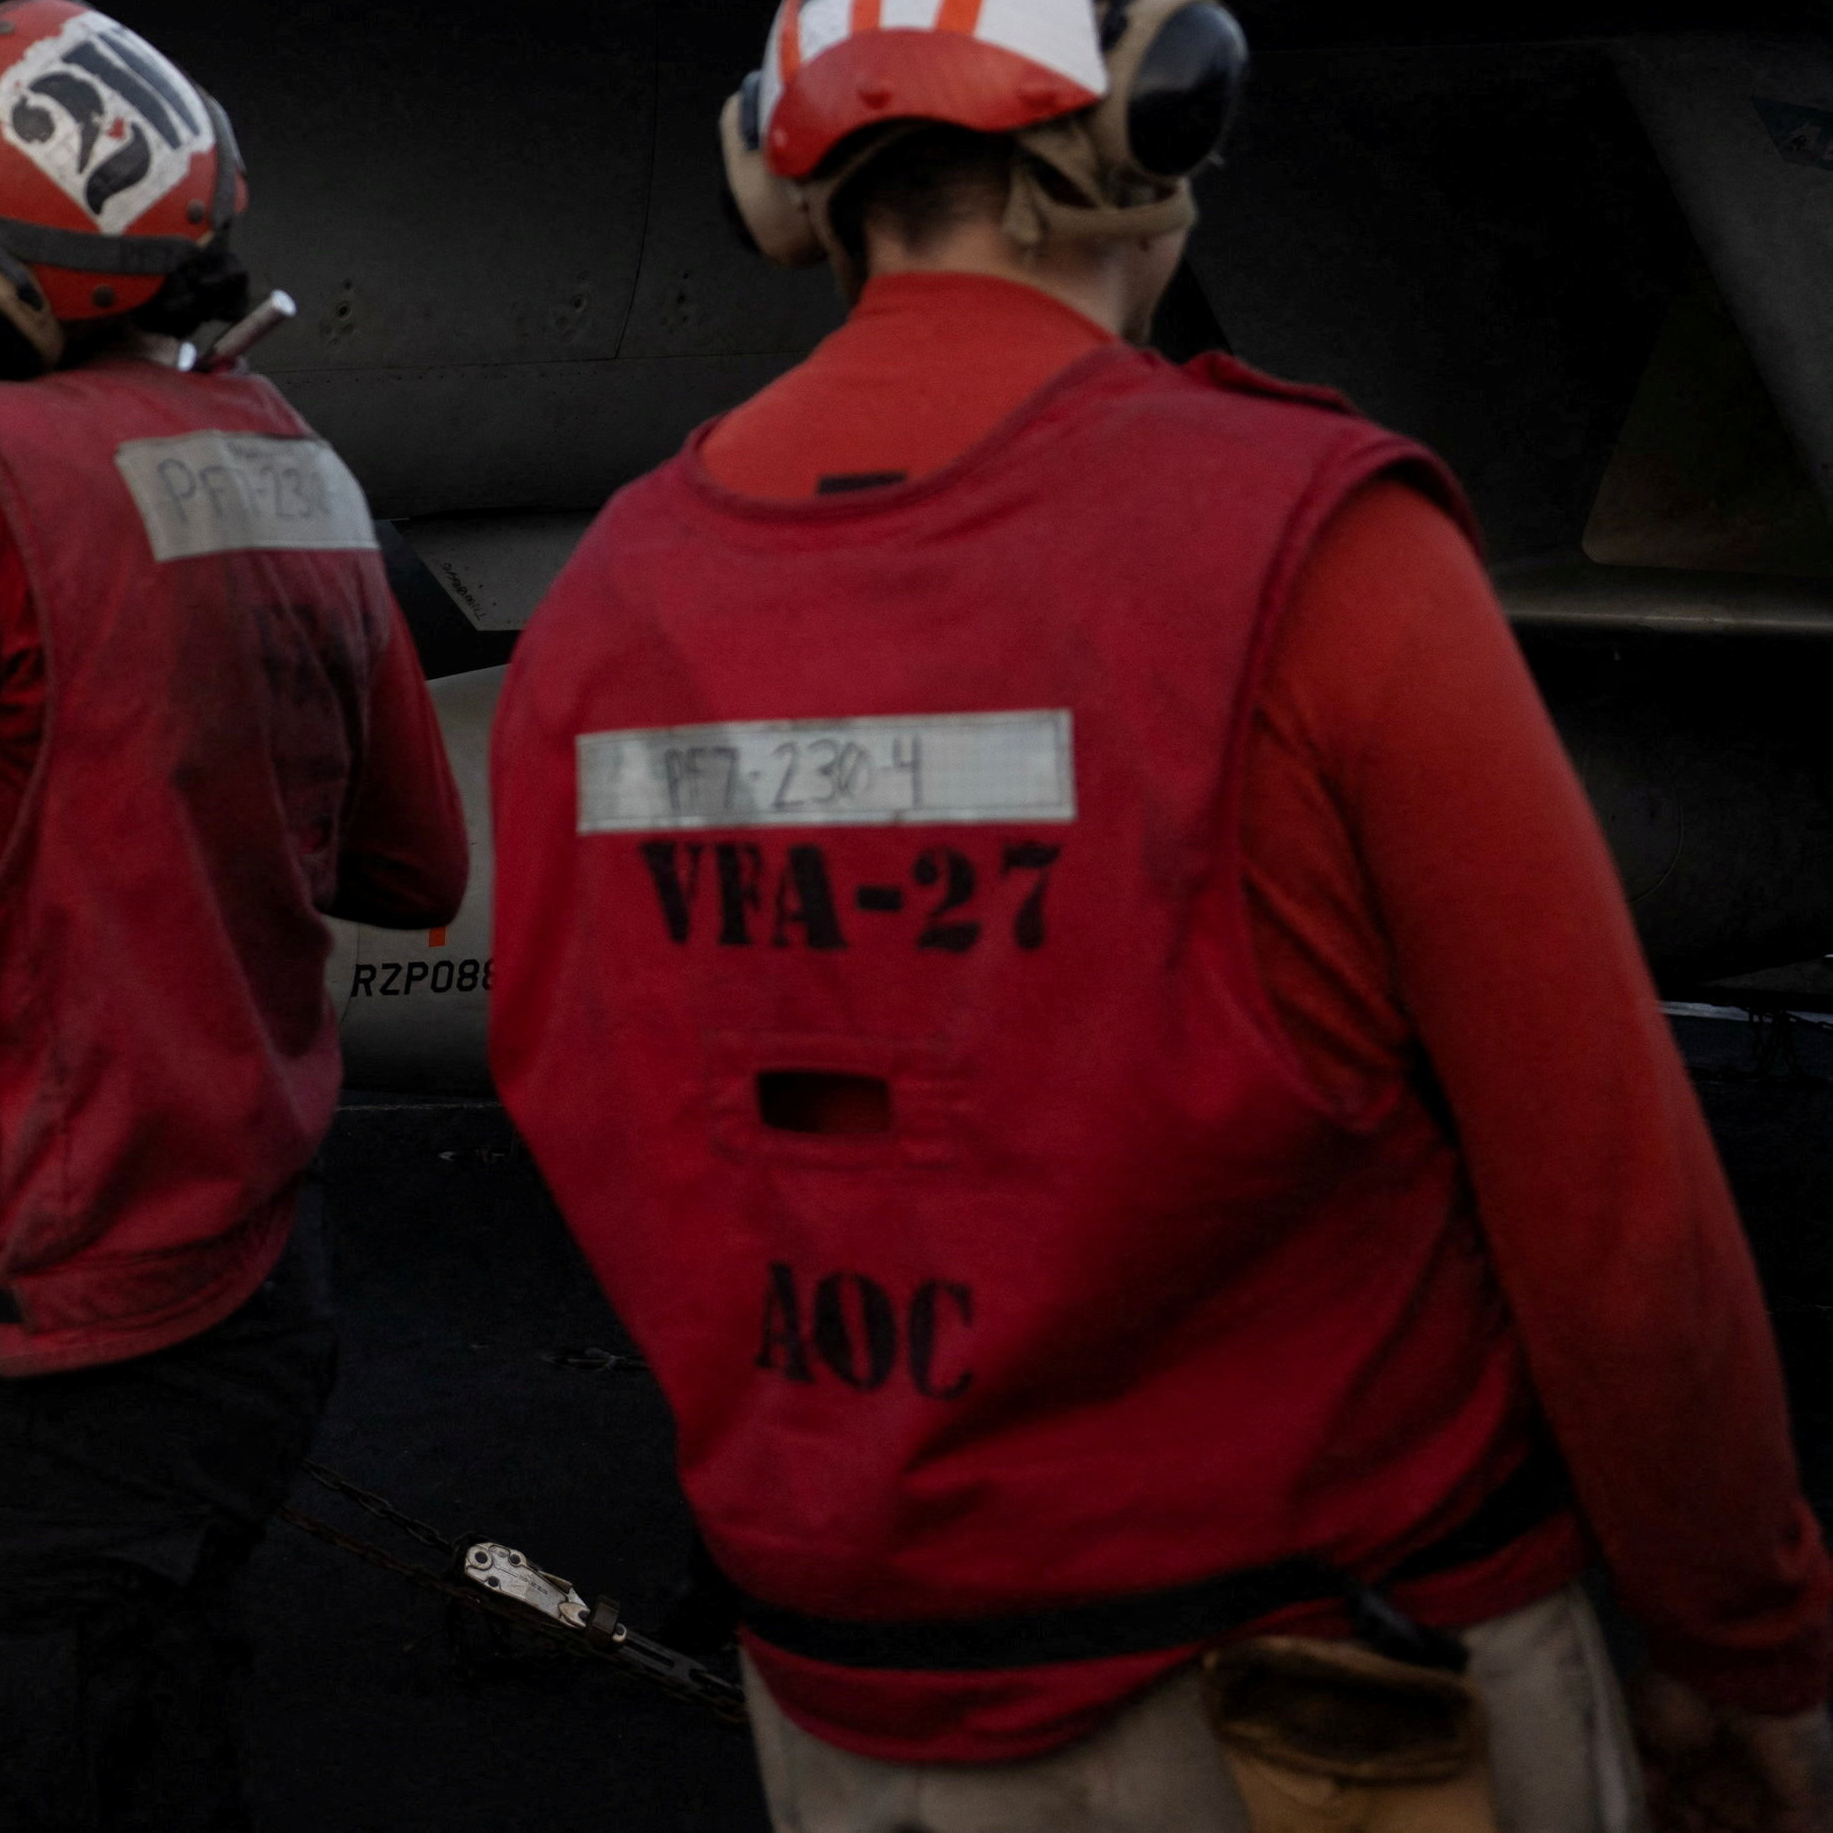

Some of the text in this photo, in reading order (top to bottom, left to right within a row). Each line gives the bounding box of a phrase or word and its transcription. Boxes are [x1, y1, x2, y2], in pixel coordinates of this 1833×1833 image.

[12, 27, 200, 217] 2W
[637, 839, 1065, 955] VFA-27
[753, 1261, 978, 1402] AOC
